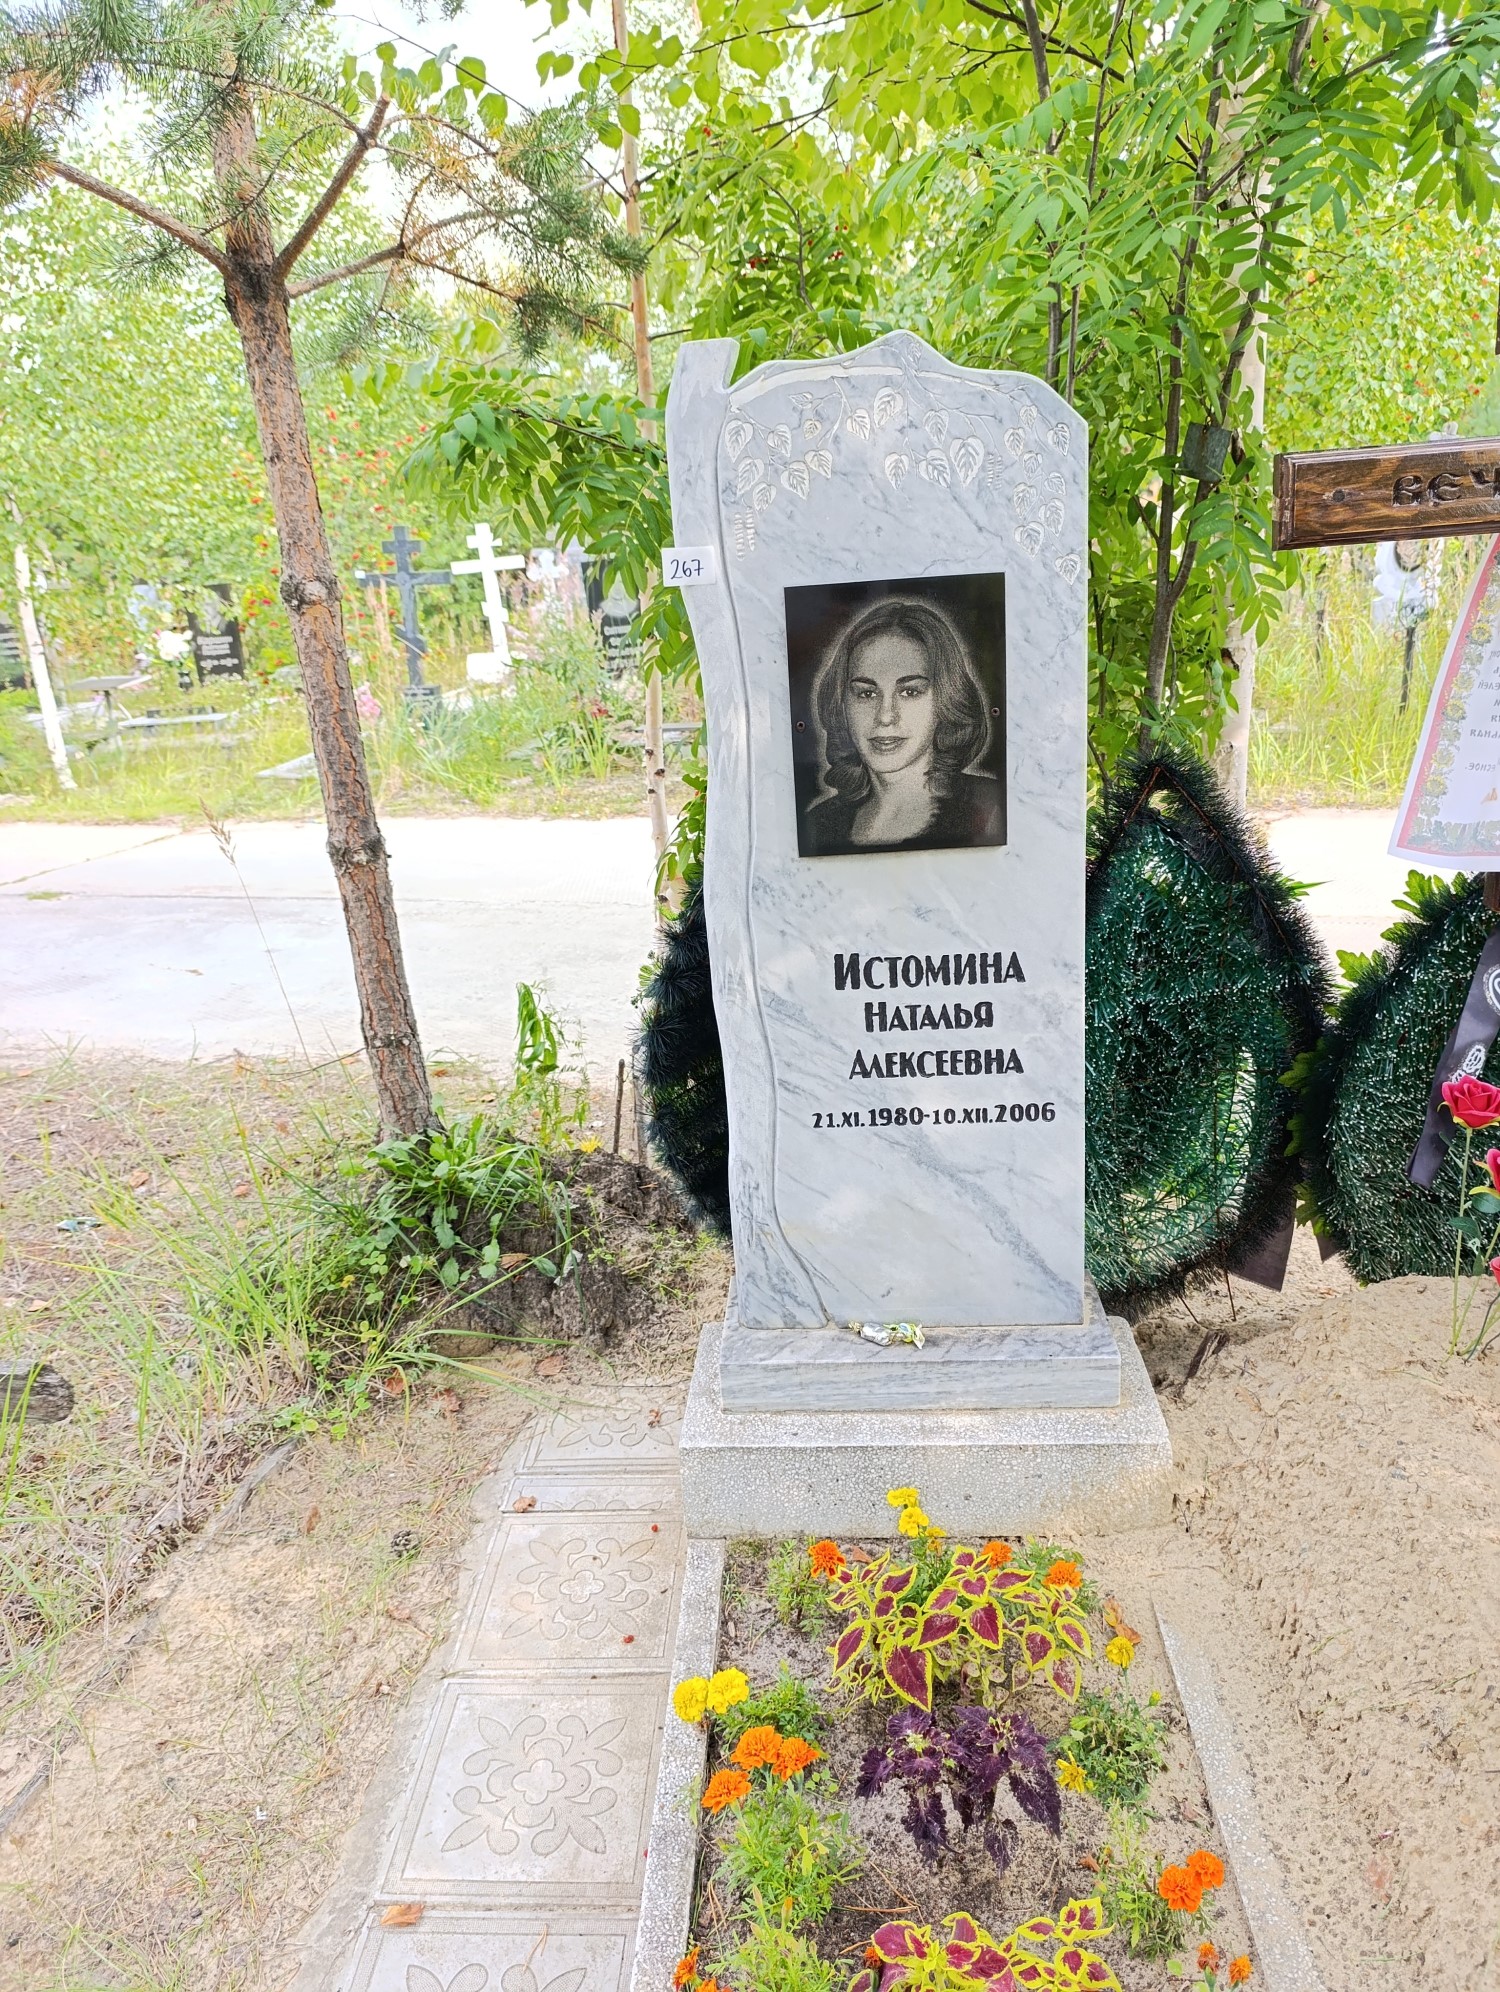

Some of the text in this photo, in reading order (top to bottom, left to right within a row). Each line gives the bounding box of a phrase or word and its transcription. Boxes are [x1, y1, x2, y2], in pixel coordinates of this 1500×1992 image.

[670, 558, 704, 580] 267
[833, 951, 1026, 990] ИСТОМИНА
[864, 1001, 994, 1032] НАТАЛЬЯ
[849, 1048, 1024, 1079] АЛЕКСЕЕВНА
